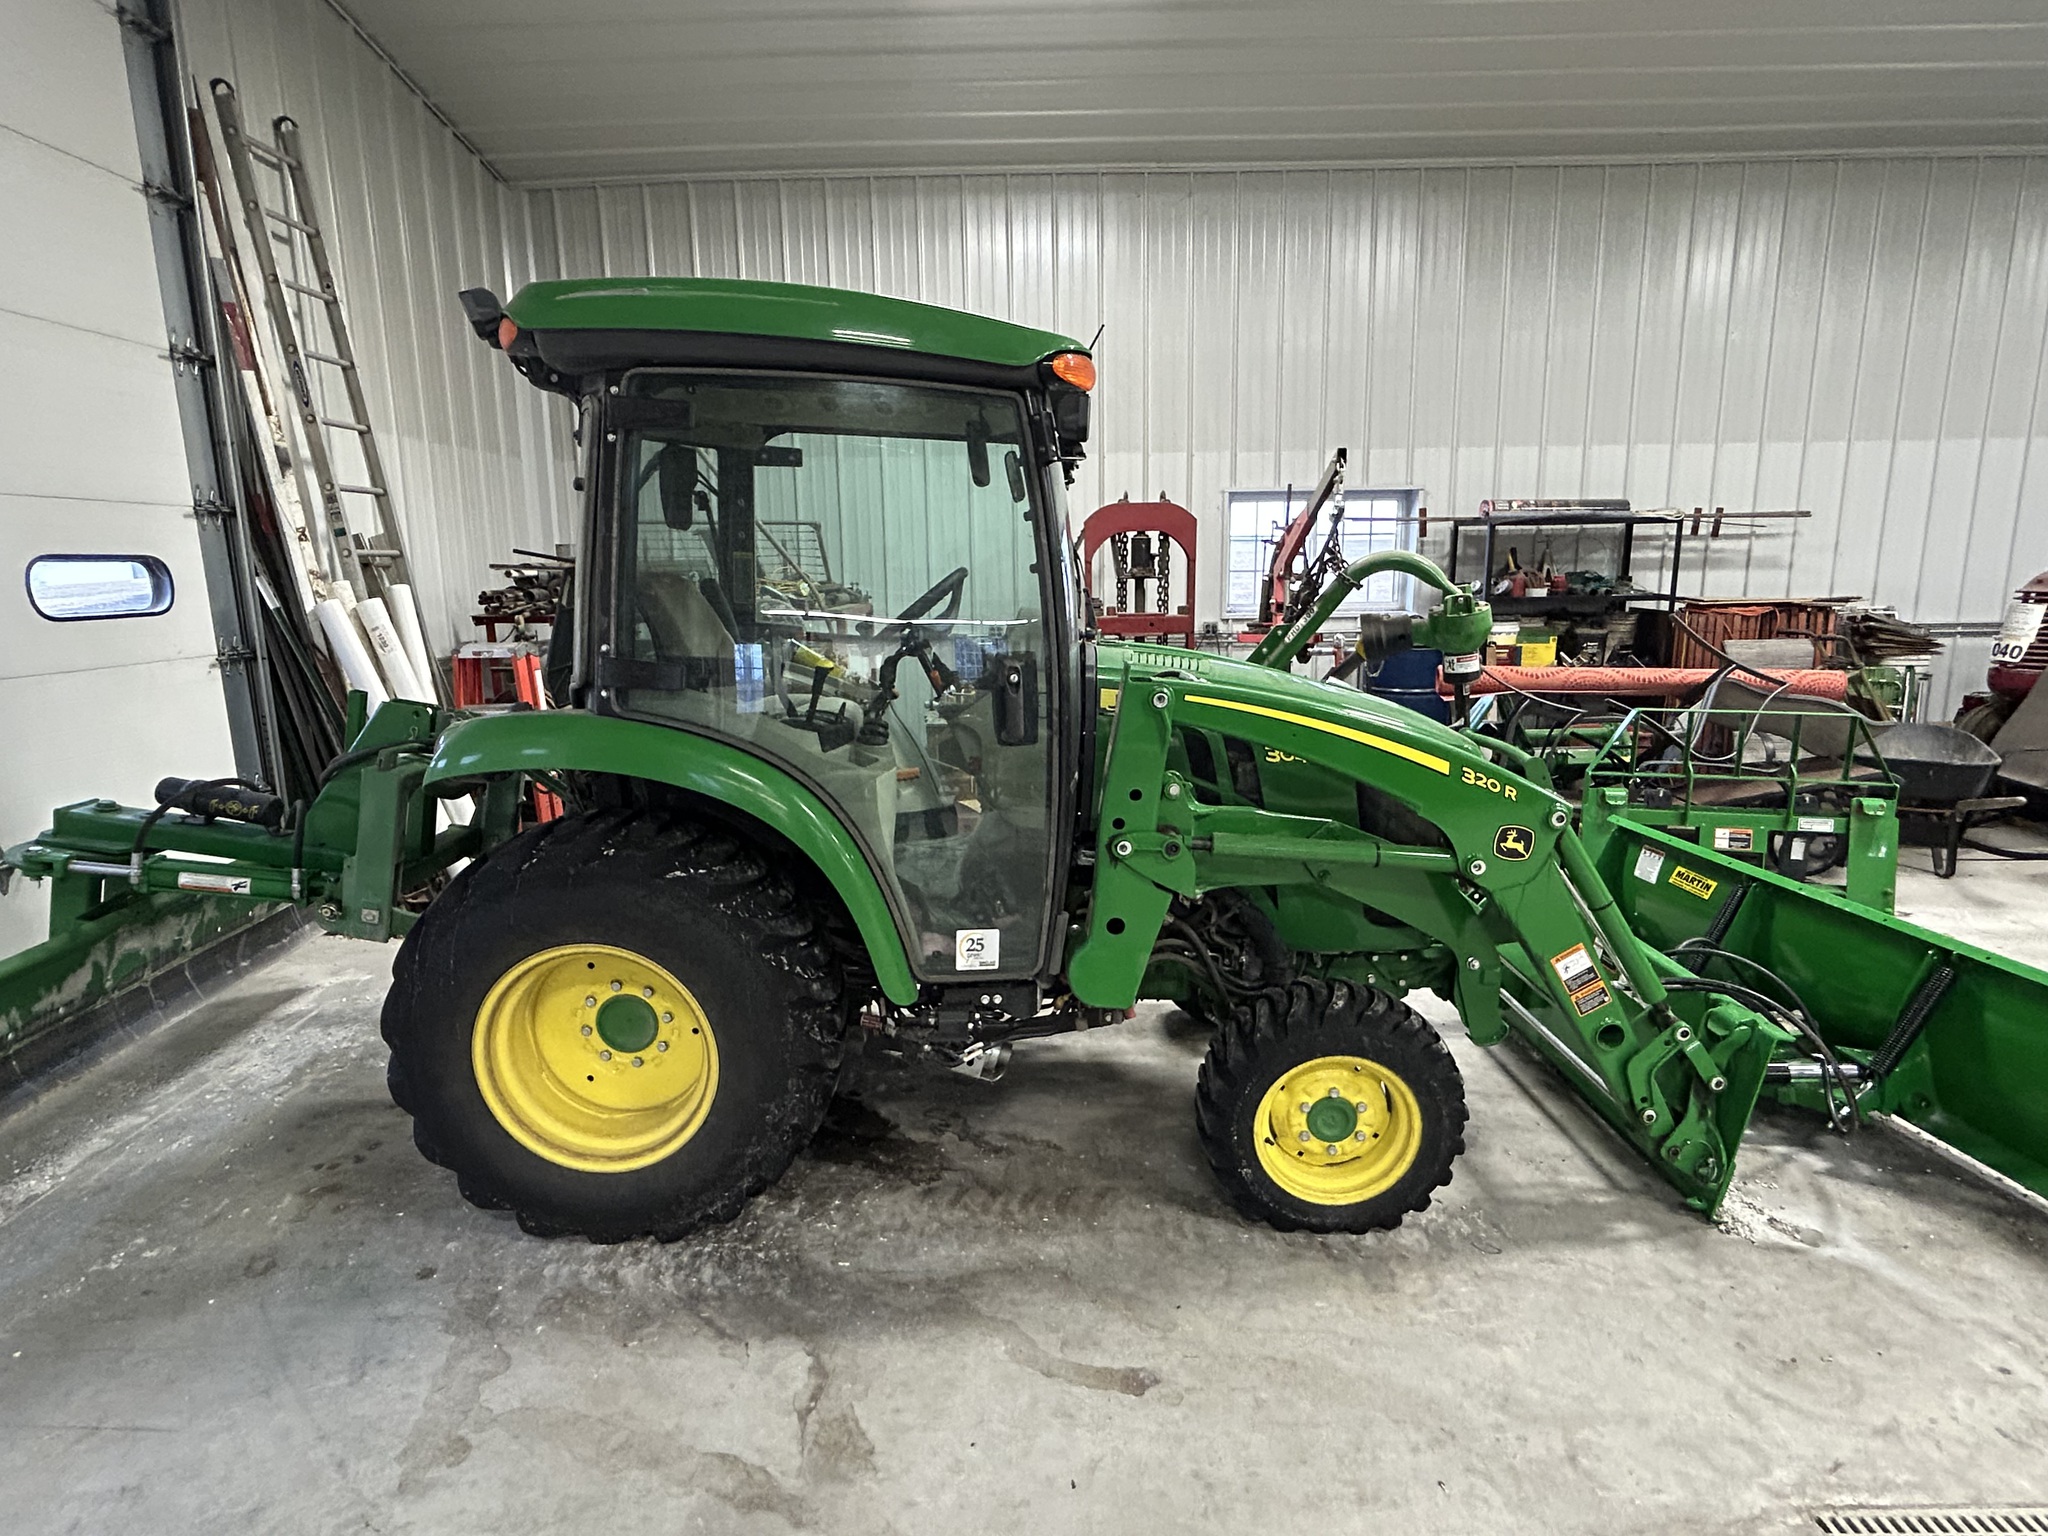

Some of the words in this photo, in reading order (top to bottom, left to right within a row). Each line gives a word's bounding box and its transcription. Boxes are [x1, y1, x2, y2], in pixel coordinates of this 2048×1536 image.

[1265, 746, 1307, 763] 30
[1462, 767, 1500, 792] 320
[1505, 785, 1517, 801] R
[1675, 870, 1712, 891] MARTIN
[966, 938, 984, 952] 25
